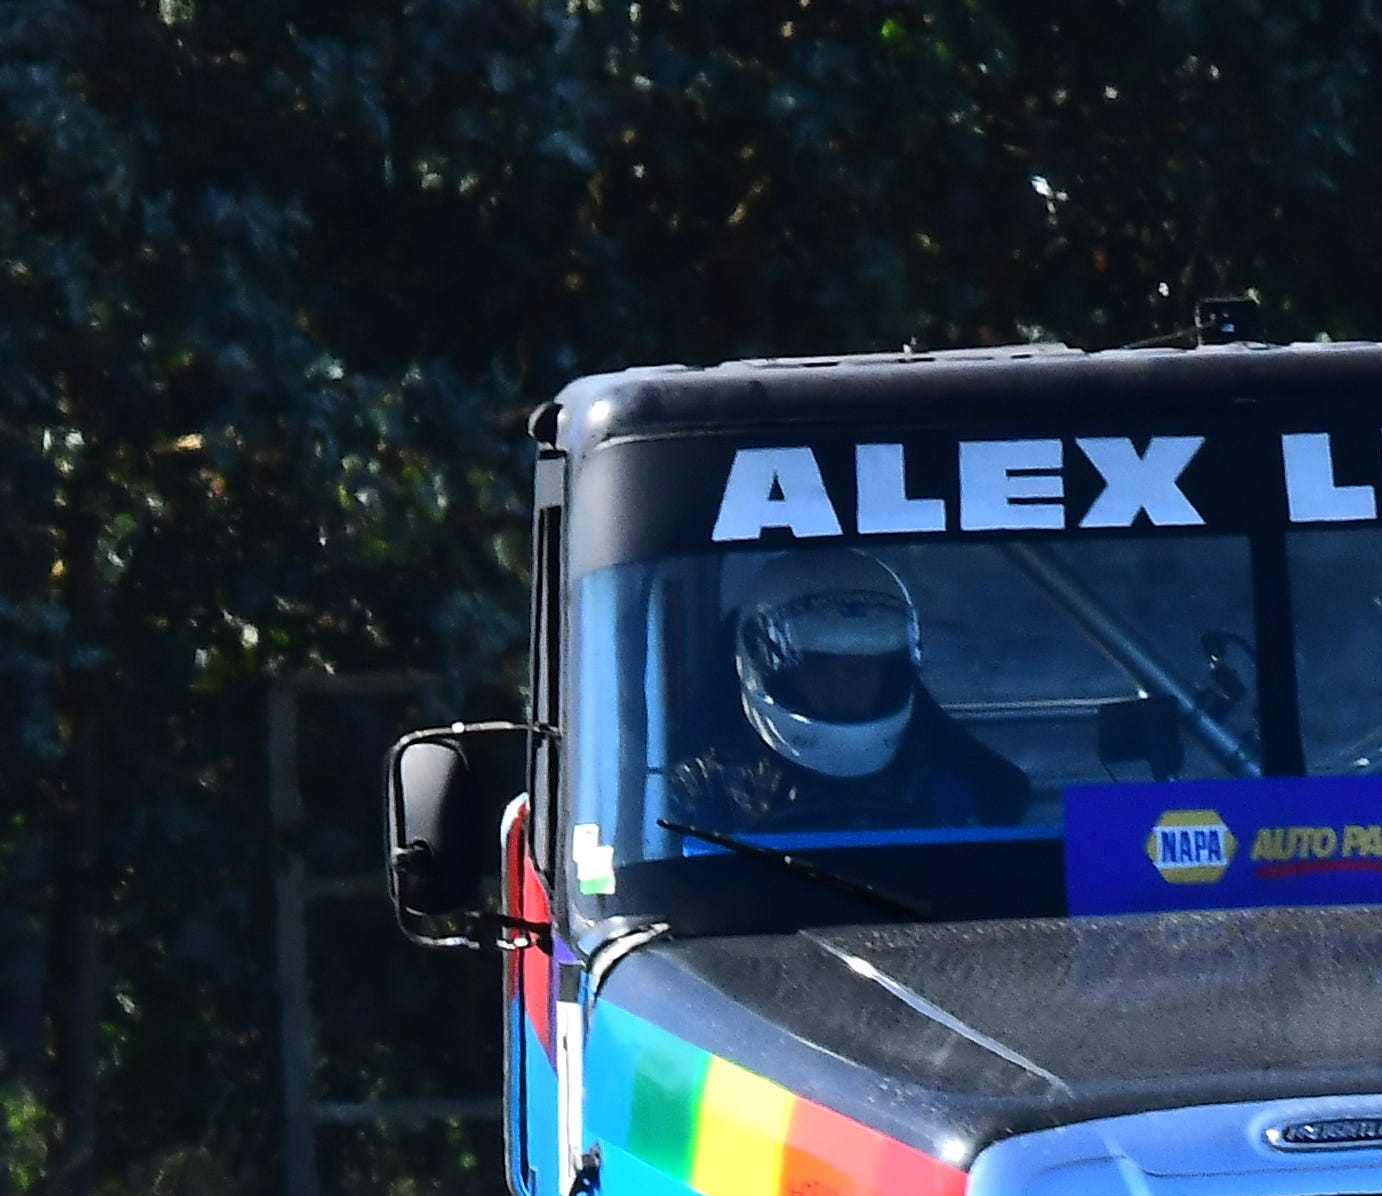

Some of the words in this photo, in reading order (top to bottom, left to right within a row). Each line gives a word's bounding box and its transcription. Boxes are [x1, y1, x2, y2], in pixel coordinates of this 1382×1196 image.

[711, 436, 1206, 542] ALEX
[1159, 829, 1225, 864] NAPA
[1252, 828, 1338, 861] AUTO
